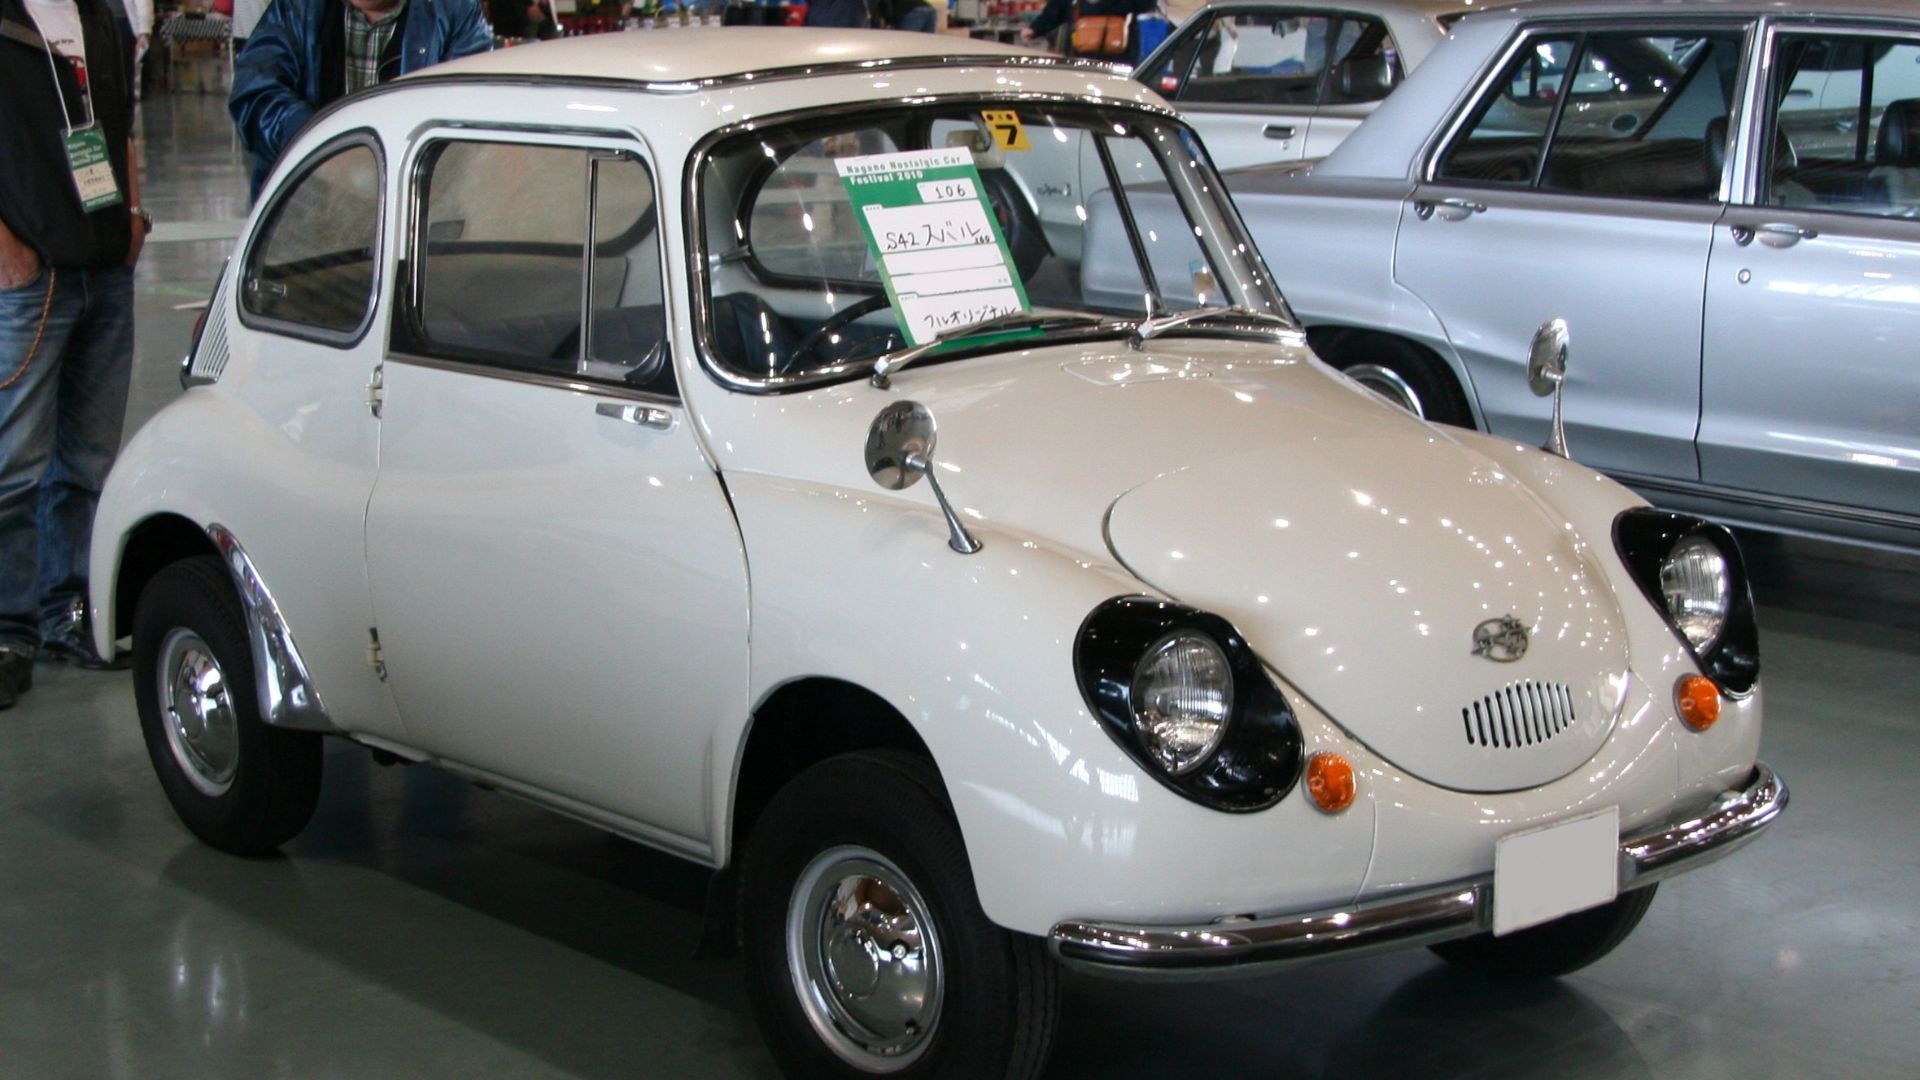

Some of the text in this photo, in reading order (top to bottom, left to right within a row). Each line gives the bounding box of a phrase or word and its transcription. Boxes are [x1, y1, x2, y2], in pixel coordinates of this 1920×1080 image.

[995, 124, 1018, 146] 7
[846, 156, 961, 174] Nagano Nostalgic Car
[850, 170, 924, 185] Festival 2010
[935, 184, 966, 199] 106
